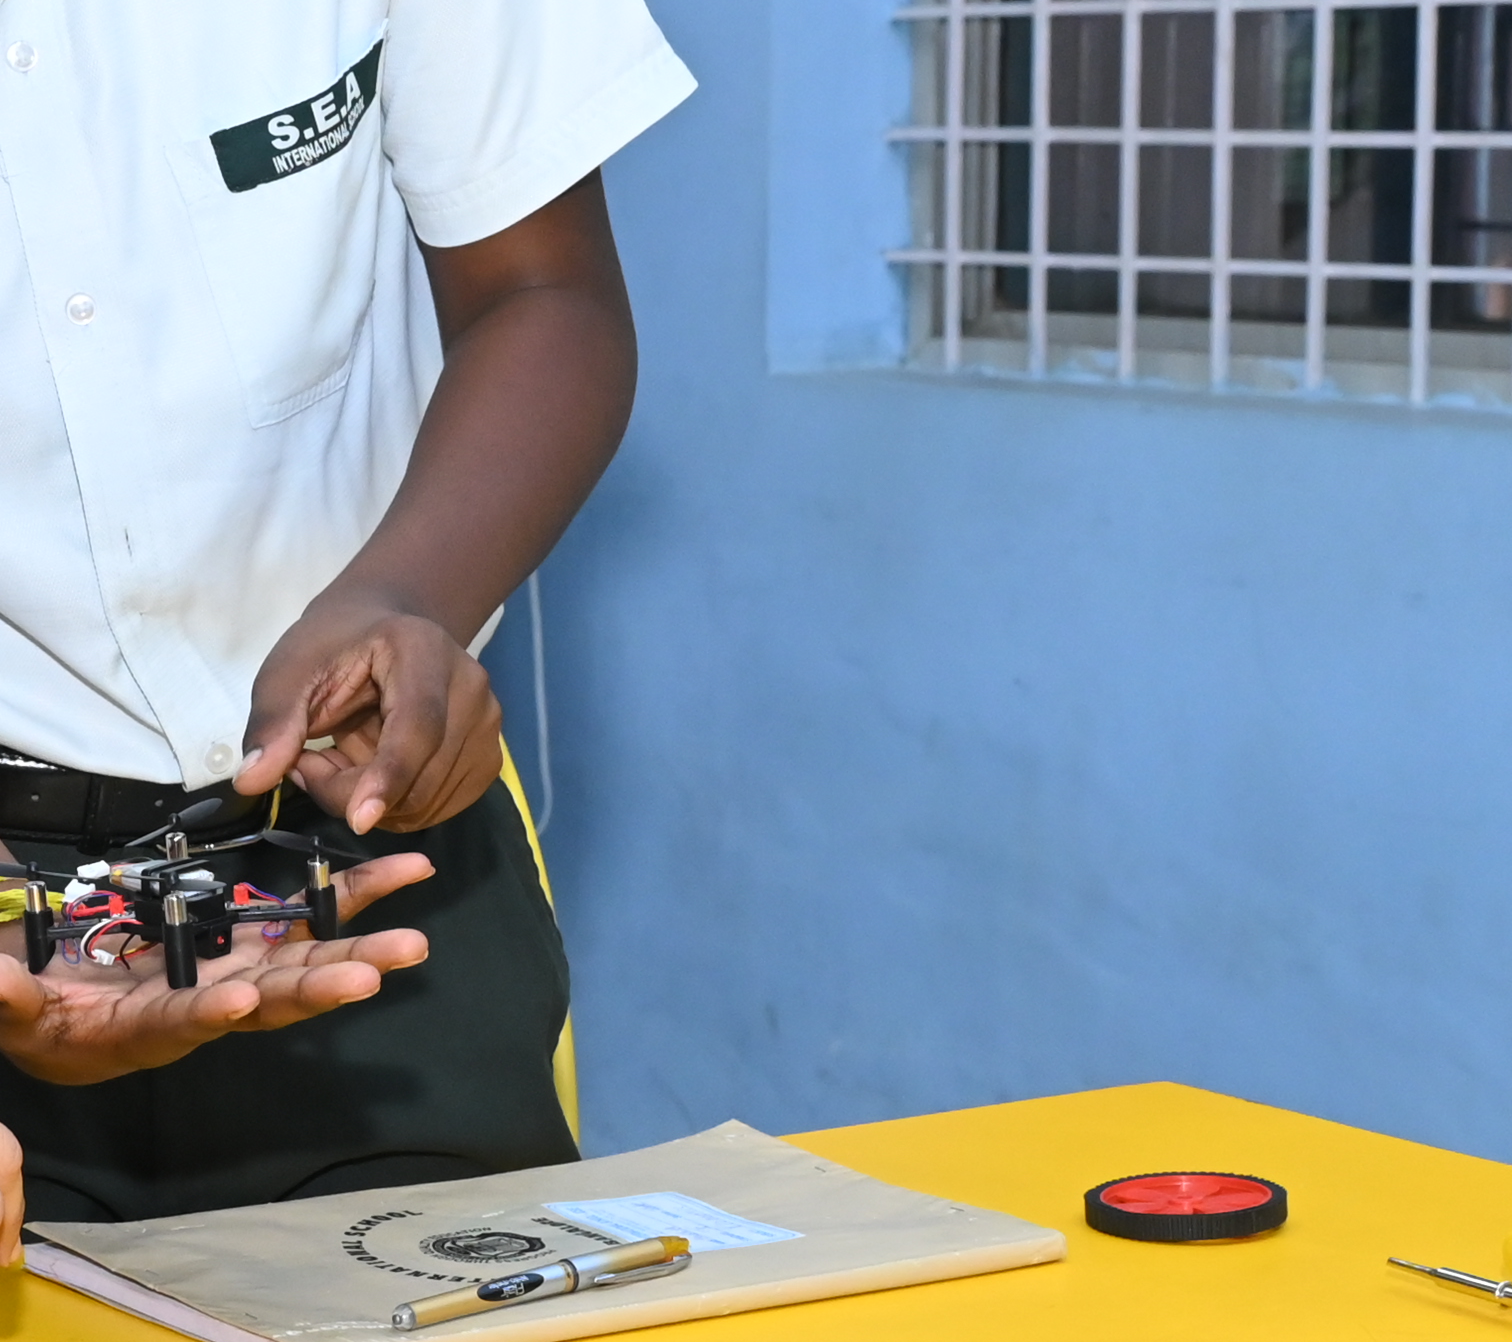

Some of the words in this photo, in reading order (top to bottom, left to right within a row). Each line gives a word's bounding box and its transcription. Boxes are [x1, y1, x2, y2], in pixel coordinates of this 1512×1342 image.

[267, 71, 362, 150] S.E.A
[272, 122, 350, 174] INTERNATIONAL
[344, 1210, 423, 1237] SCHOOL
[341, 1240, 483, 1283] TERNATIONAL
